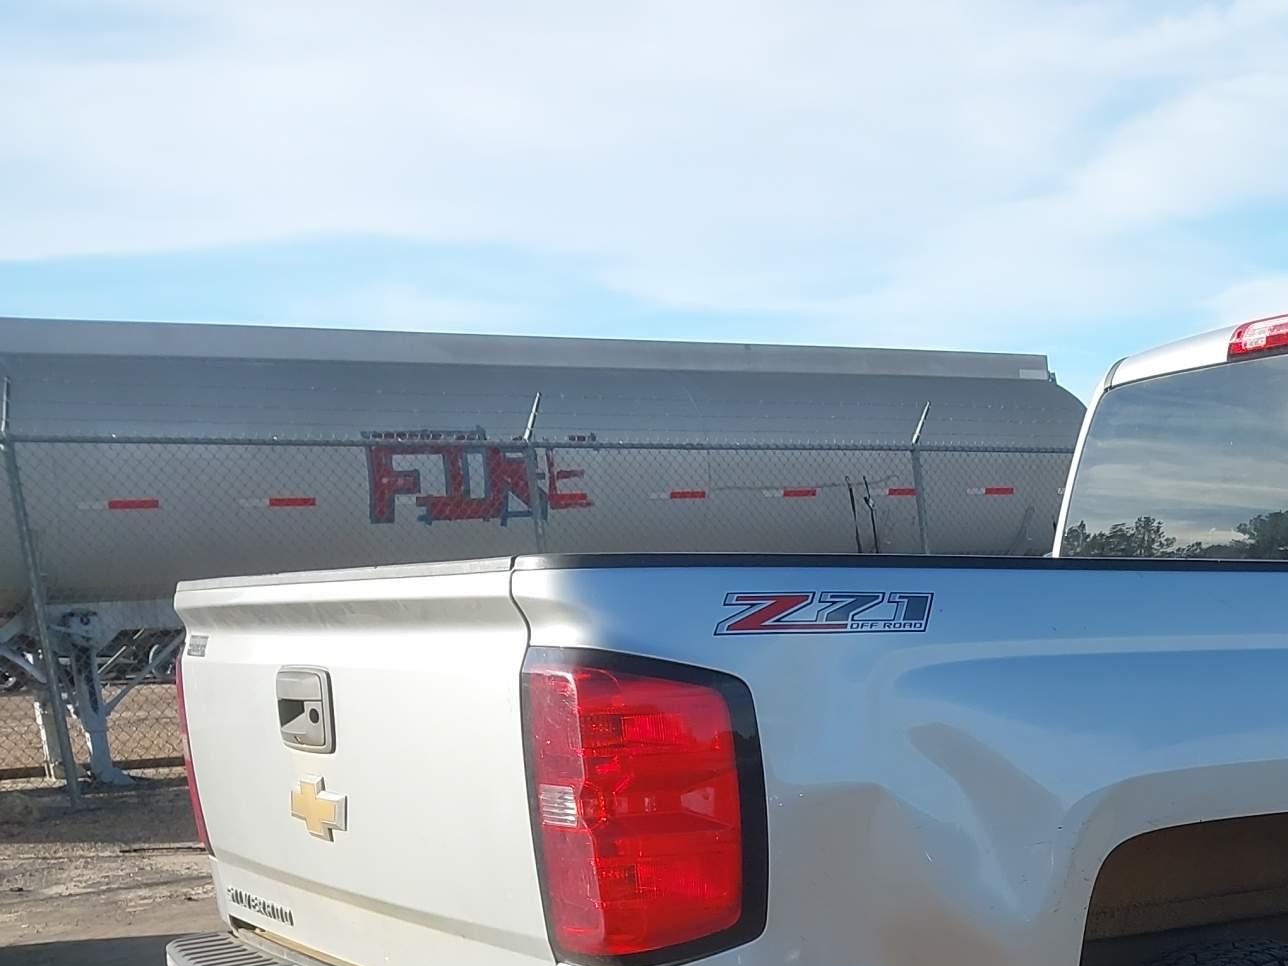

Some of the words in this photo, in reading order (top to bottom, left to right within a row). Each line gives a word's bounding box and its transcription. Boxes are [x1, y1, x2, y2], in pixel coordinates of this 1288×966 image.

[714, 590, 934, 635] Z71
[849, 622, 879, 630] OFF
[882, 621, 924, 629] ROAD
